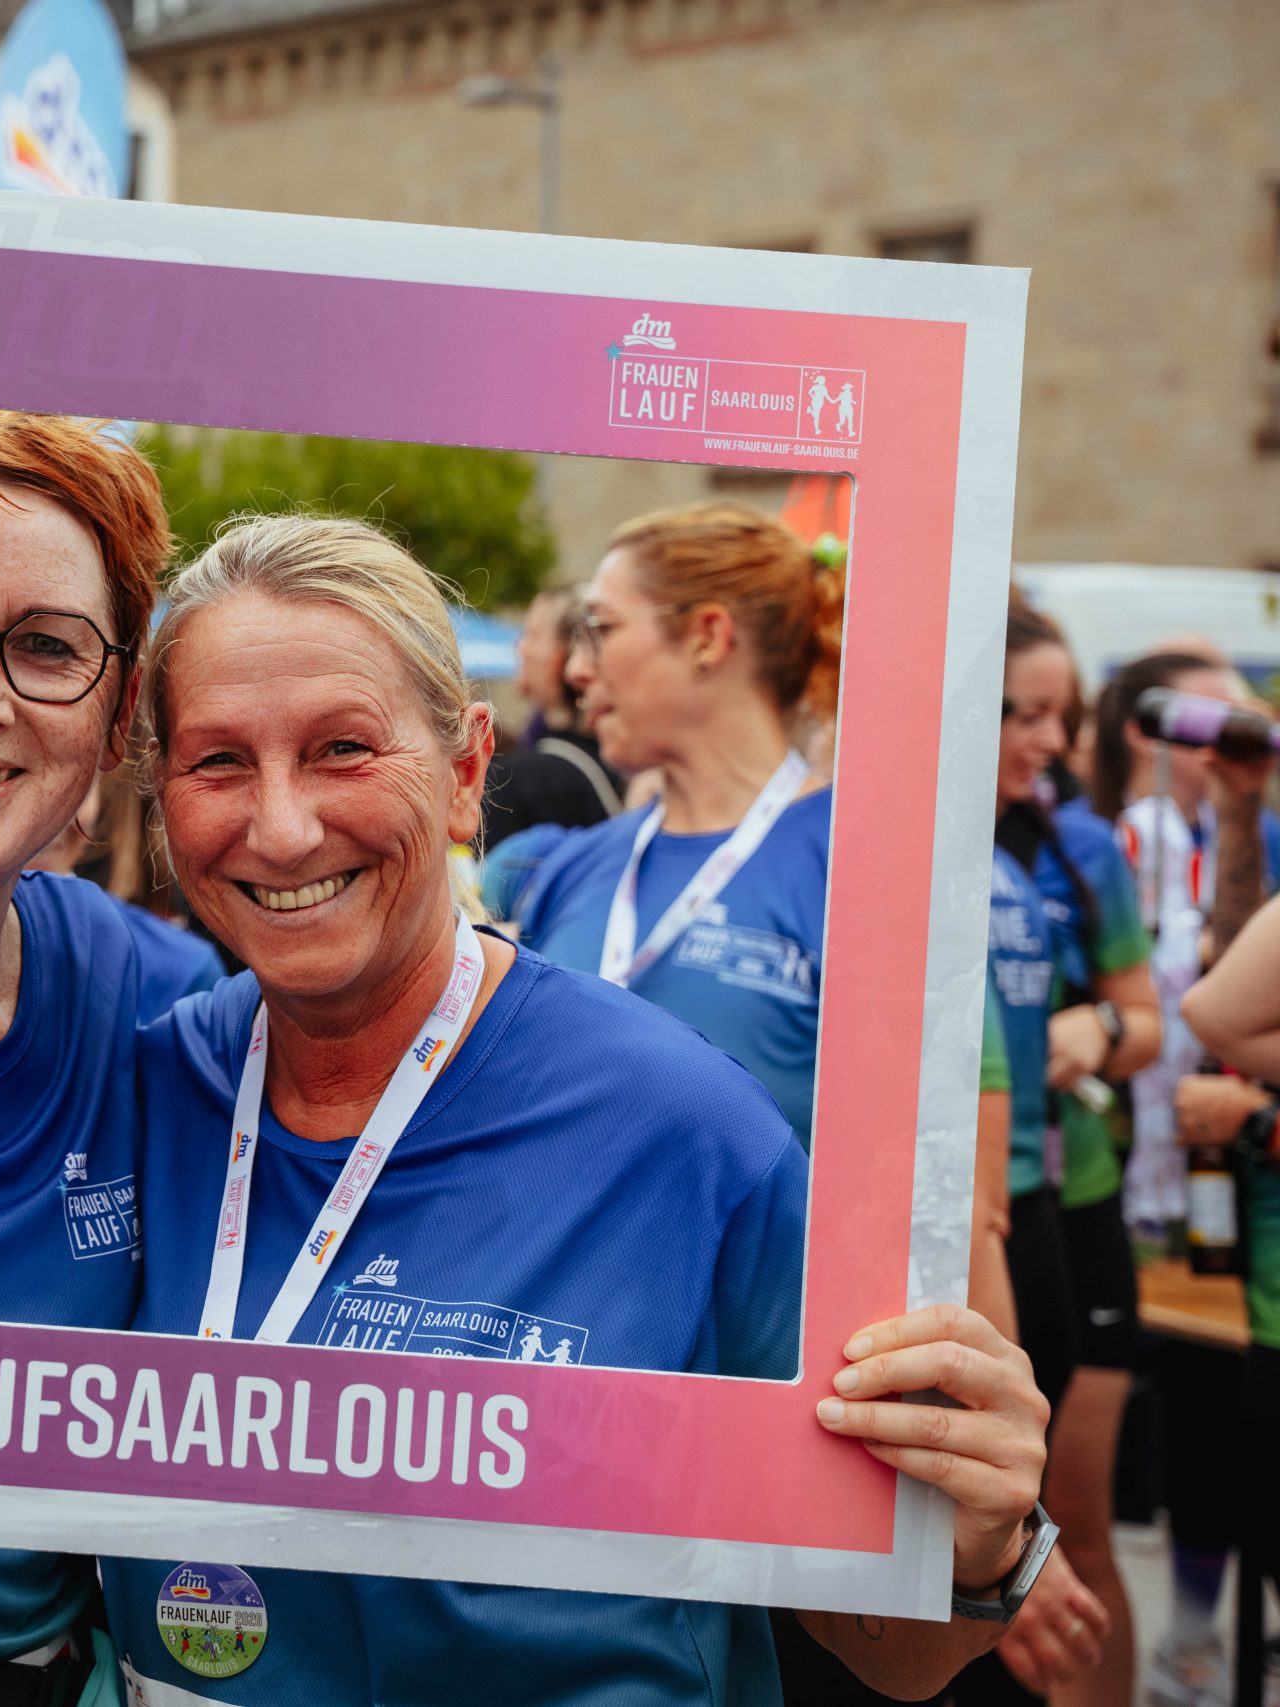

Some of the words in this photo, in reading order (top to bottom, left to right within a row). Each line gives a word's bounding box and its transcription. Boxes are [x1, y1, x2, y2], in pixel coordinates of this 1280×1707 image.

[632, 313, 672, 337] dm
[621, 361, 699, 389] FRAUEN
[619, 388, 697, 422] LAUF
[710, 390, 795, 412] SAARLOUIS
[703, 438, 860, 460] WWW.FRAUENLAUF-SAARLOUIS.DE
[413, 1036, 436, 1063] dm
[238, 1134, 251, 1158] dm
[67, 1191, 113, 1218] FRAUEN
[331, 1184, 347, 1207] FRAUEN
[338, 1187, 356, 1211] LAUF
[72, 1214, 121, 1250] LAUF
[308, 1230, 328, 1256] dm
[365, 1254, 400, 1275] dm
[336, 1297, 413, 1327] FRAUEN
[421, 1311, 510, 1339] SAARLOUIS
[178, 1571, 205, 1588] dm
[161, 1606, 231, 1623] FRAUENLAUF
[234, 1610, 263, 1627] 2026
[186, 1656, 237, 1674] SAARLOUIS
